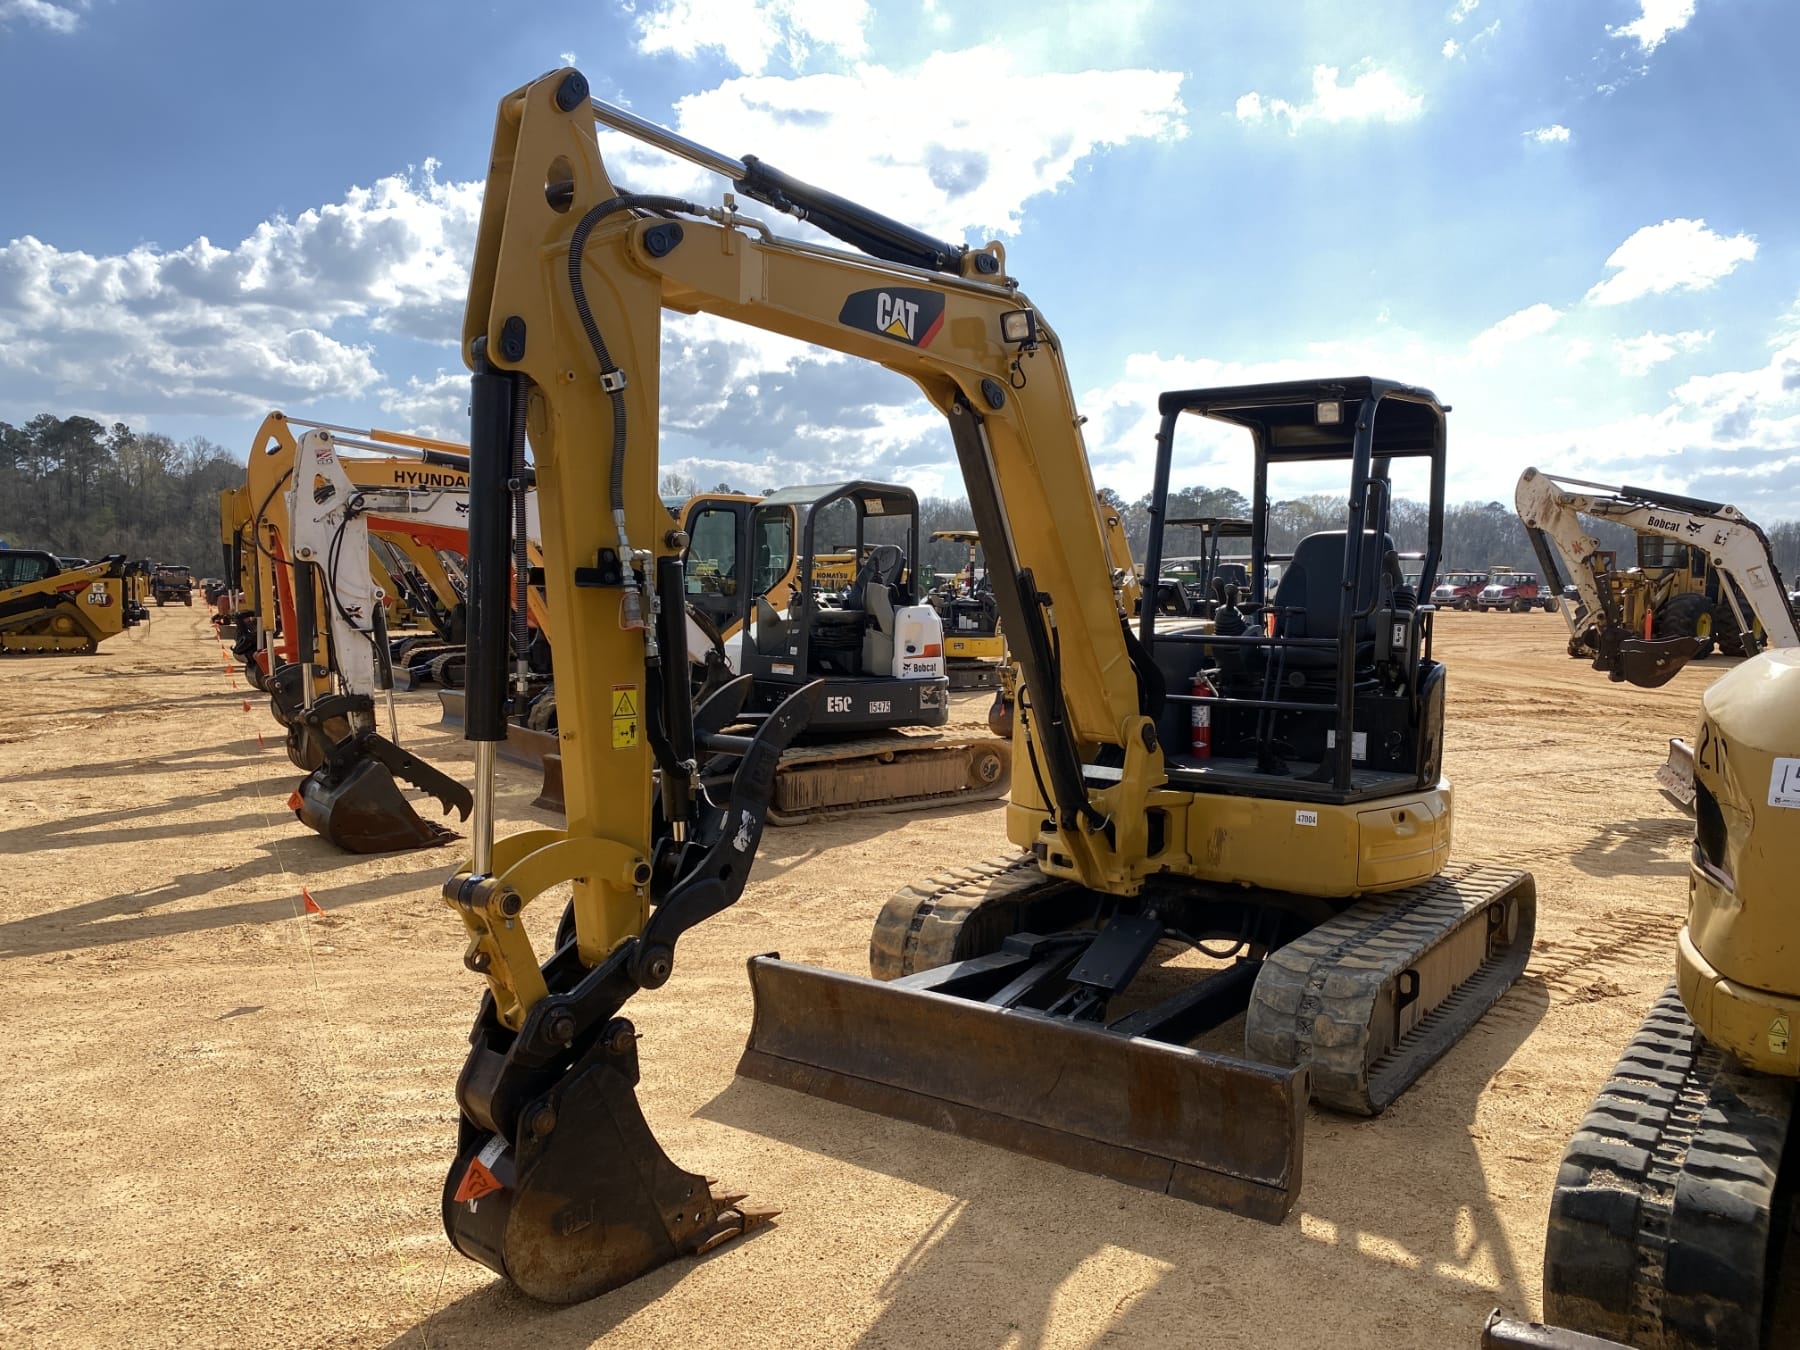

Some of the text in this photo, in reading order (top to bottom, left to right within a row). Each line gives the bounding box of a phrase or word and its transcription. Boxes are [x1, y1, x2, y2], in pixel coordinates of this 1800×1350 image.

[876, 292, 919, 341] CAT
[1647, 516, 1681, 532] Bobcat
[87, 593, 108, 605] CAT
[913, 663, 937, 673] Bobcat
